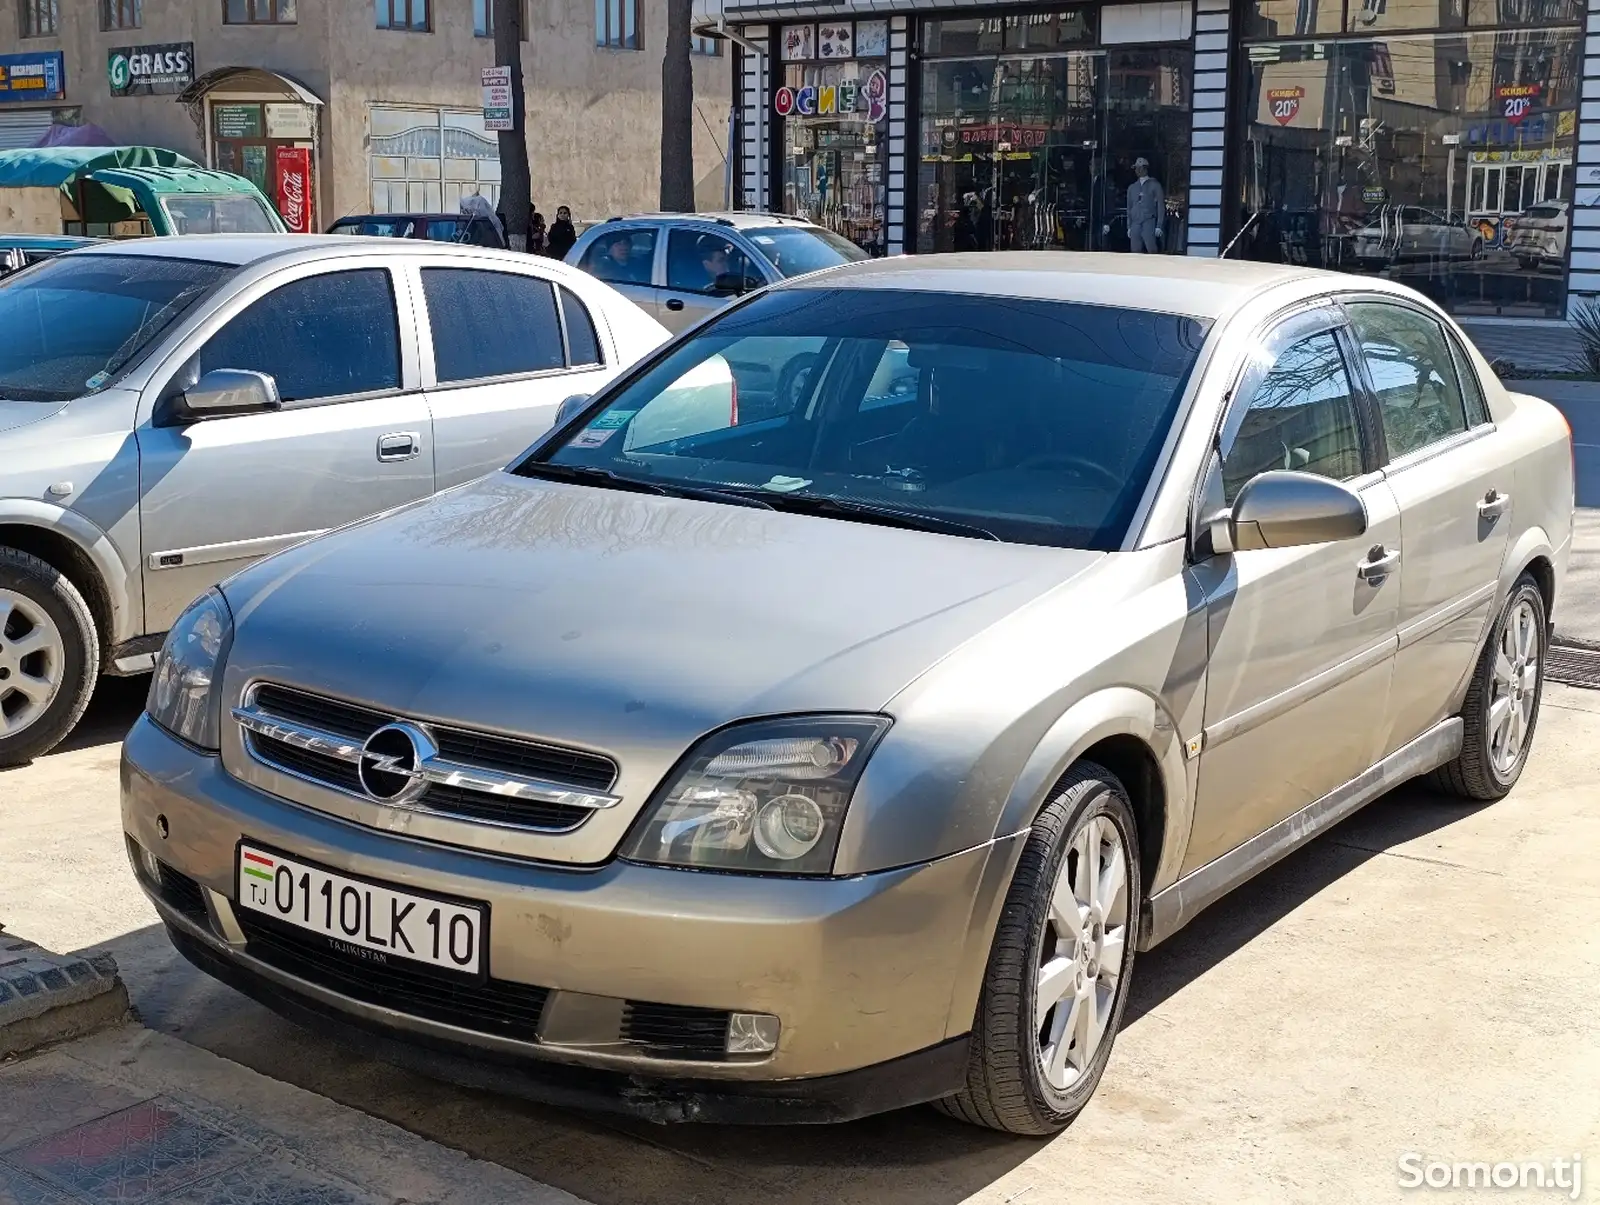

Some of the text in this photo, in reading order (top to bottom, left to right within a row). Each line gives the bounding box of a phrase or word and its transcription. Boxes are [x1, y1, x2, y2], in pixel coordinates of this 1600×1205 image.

[129, 51, 187, 76] GRASS
[1271, 90, 1300, 98] СКИДКА
[1499, 87, 1534, 97] СКИДКА
[1275, 100, 1297, 117] 20%
[1504, 97, 1530, 117] 20%
[250, 883, 267, 906] TJ
[327, 939, 388, 964] TAJIKISTAN
